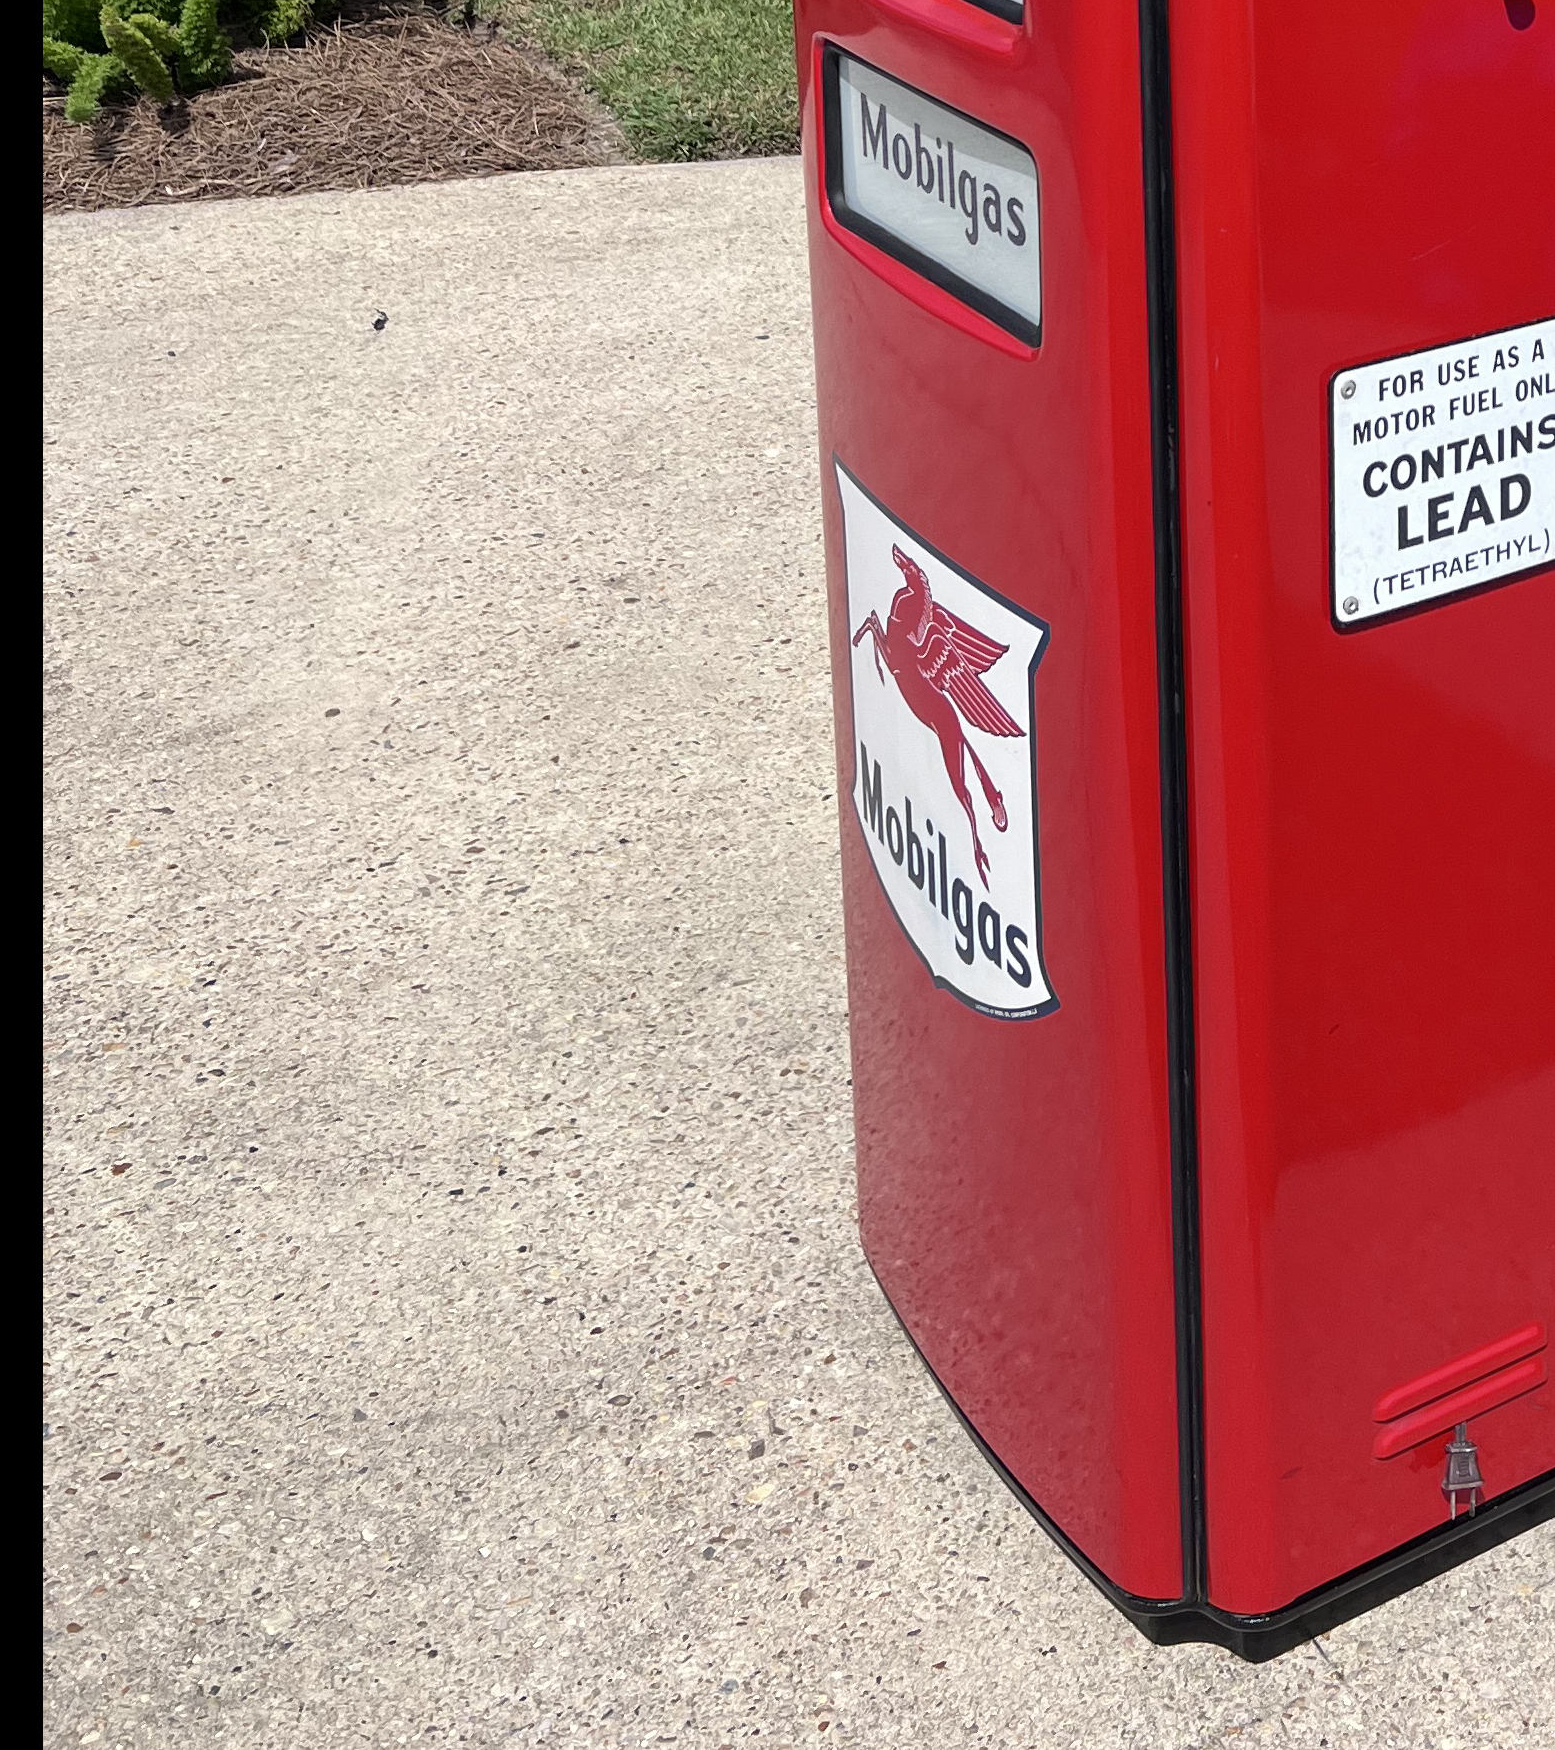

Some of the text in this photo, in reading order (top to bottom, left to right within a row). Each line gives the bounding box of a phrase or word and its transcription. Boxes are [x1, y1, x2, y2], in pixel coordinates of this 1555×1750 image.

[860, 92, 1027, 247] Mobilgas
[1378, 338, 1545, 402] FOR USE AS A
[1352, 404, 1436, 446] MOTOR
[1449, 387, 1503, 420] FUEL
[1397, 473, 1532, 551] LEAD
[1373, 528, 1551, 604] (TETRAETHYL)
[860, 740, 1032, 988] Mobilgas
